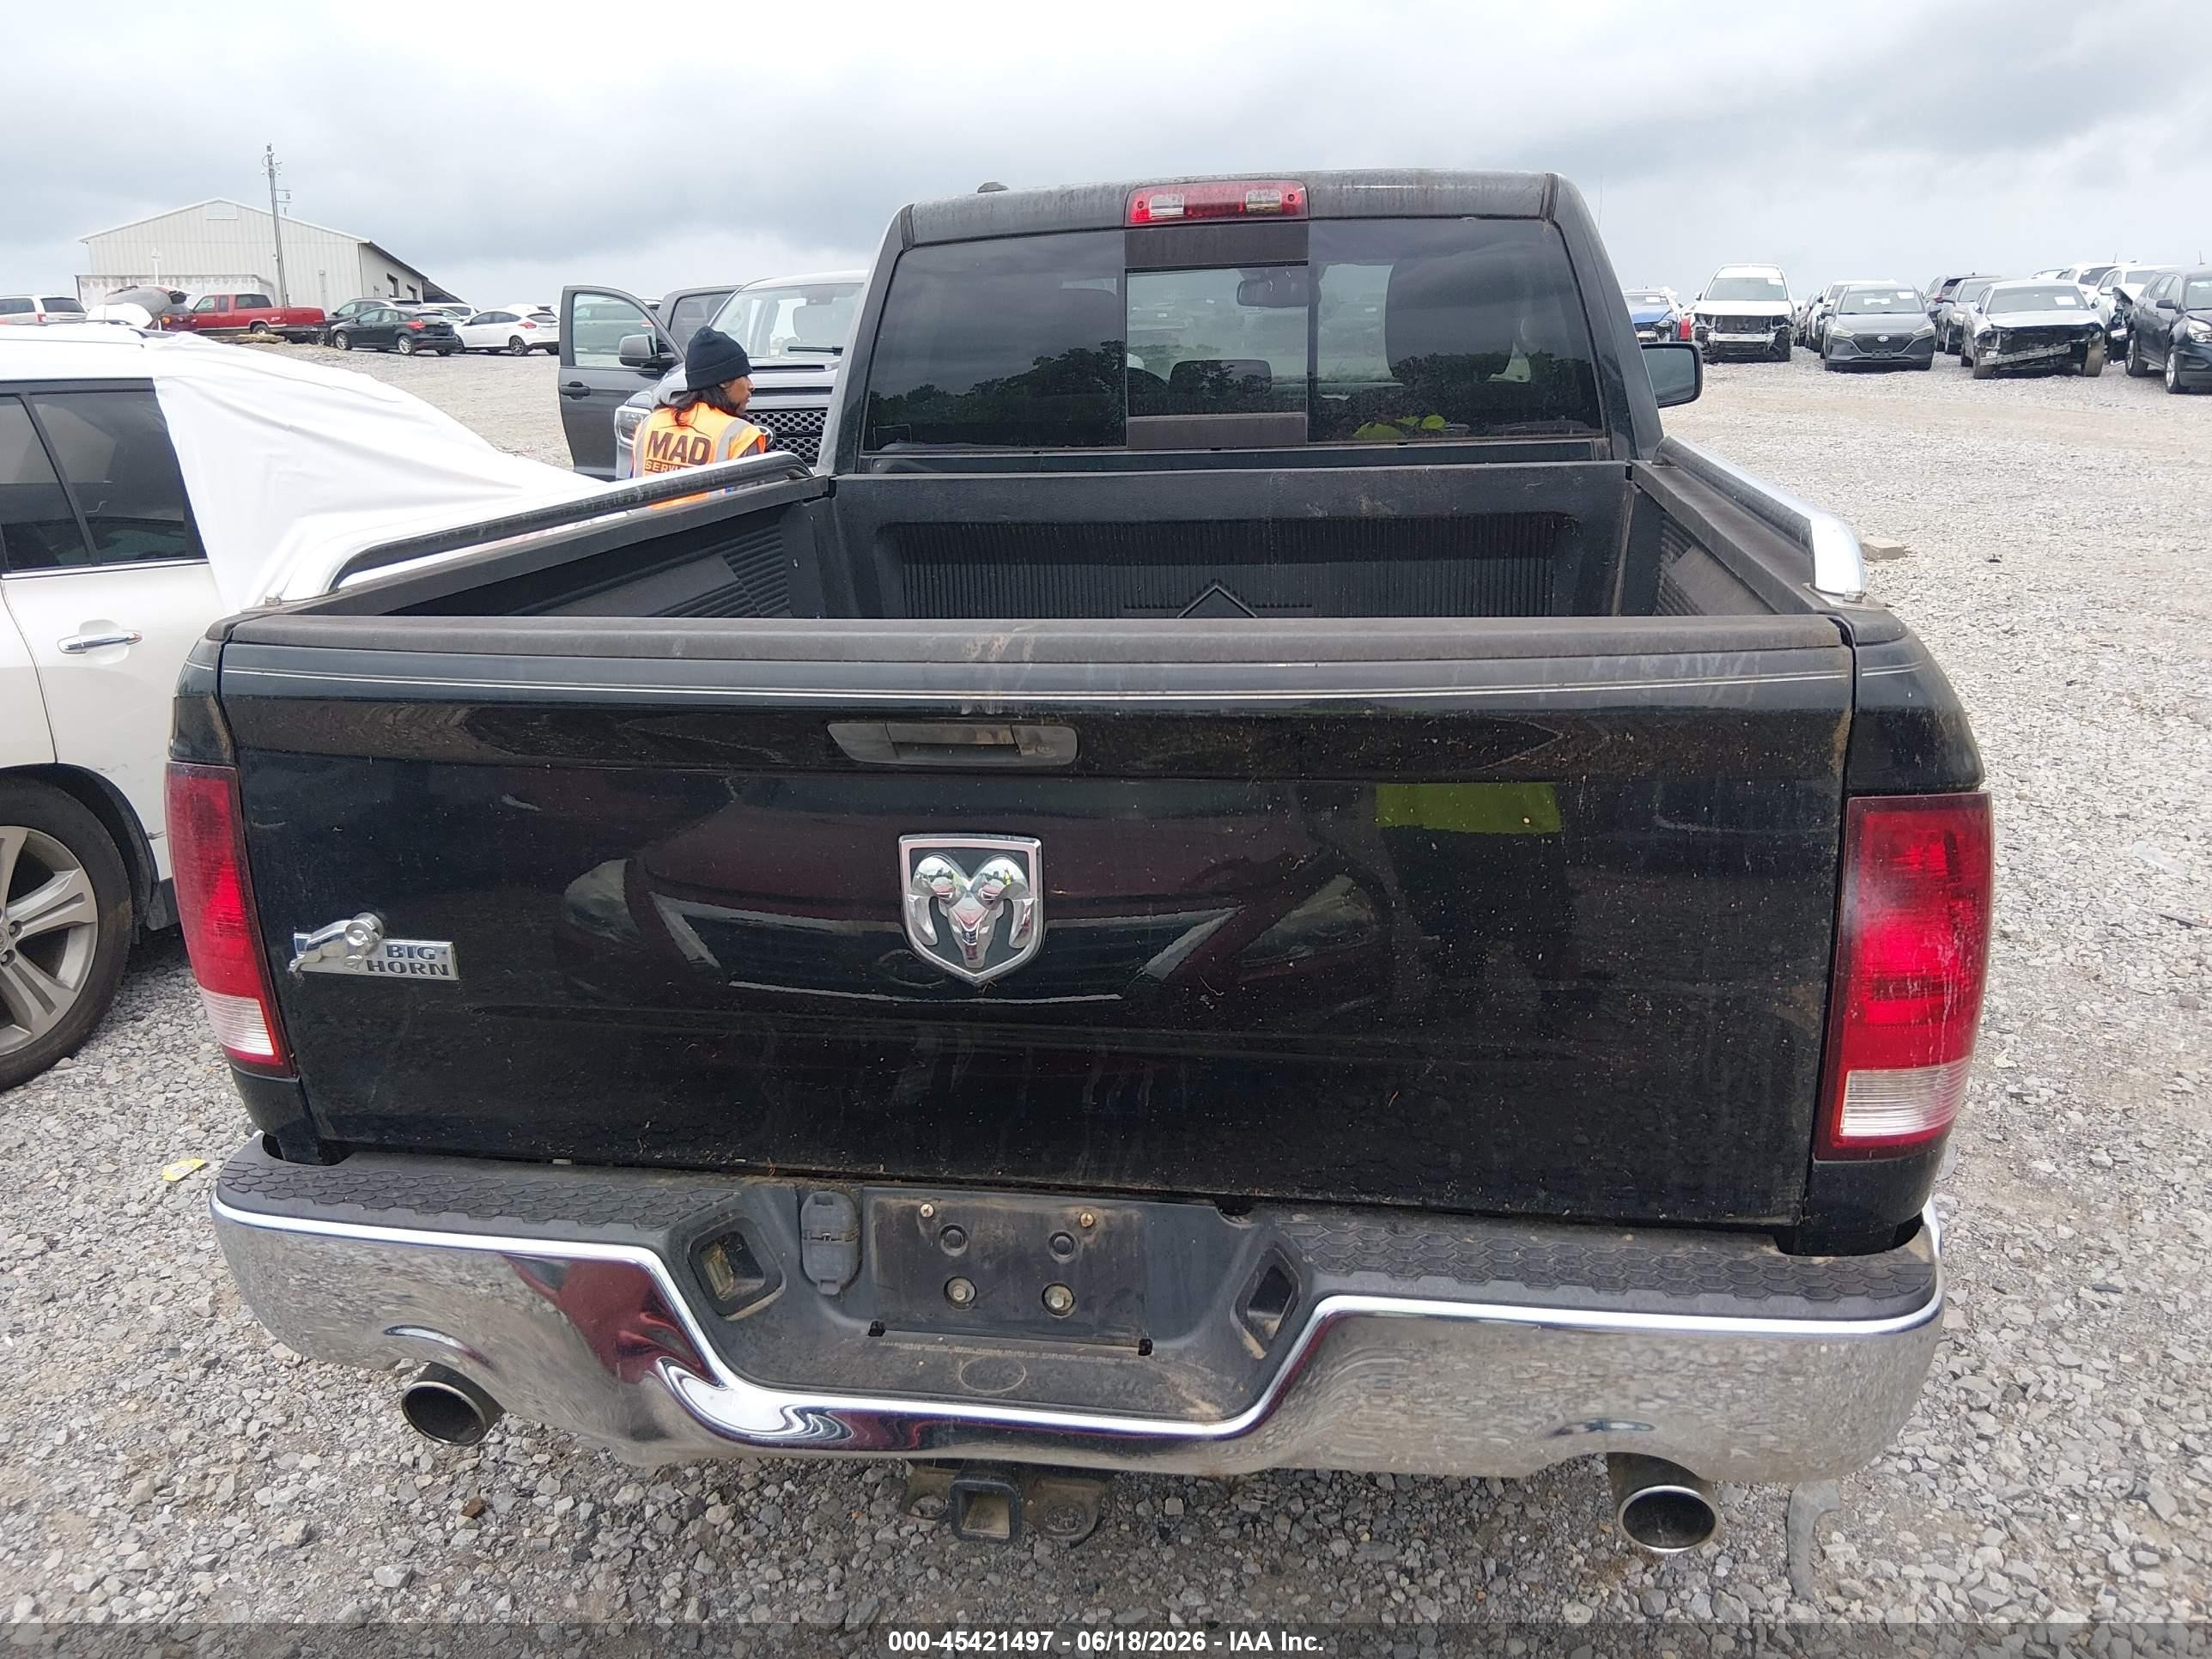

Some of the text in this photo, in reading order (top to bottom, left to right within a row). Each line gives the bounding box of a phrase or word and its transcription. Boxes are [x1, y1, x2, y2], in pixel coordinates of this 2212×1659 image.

[646, 430, 712, 466] MAD
[386, 945, 436, 960] BIG
[366, 959, 450, 976] HORN
